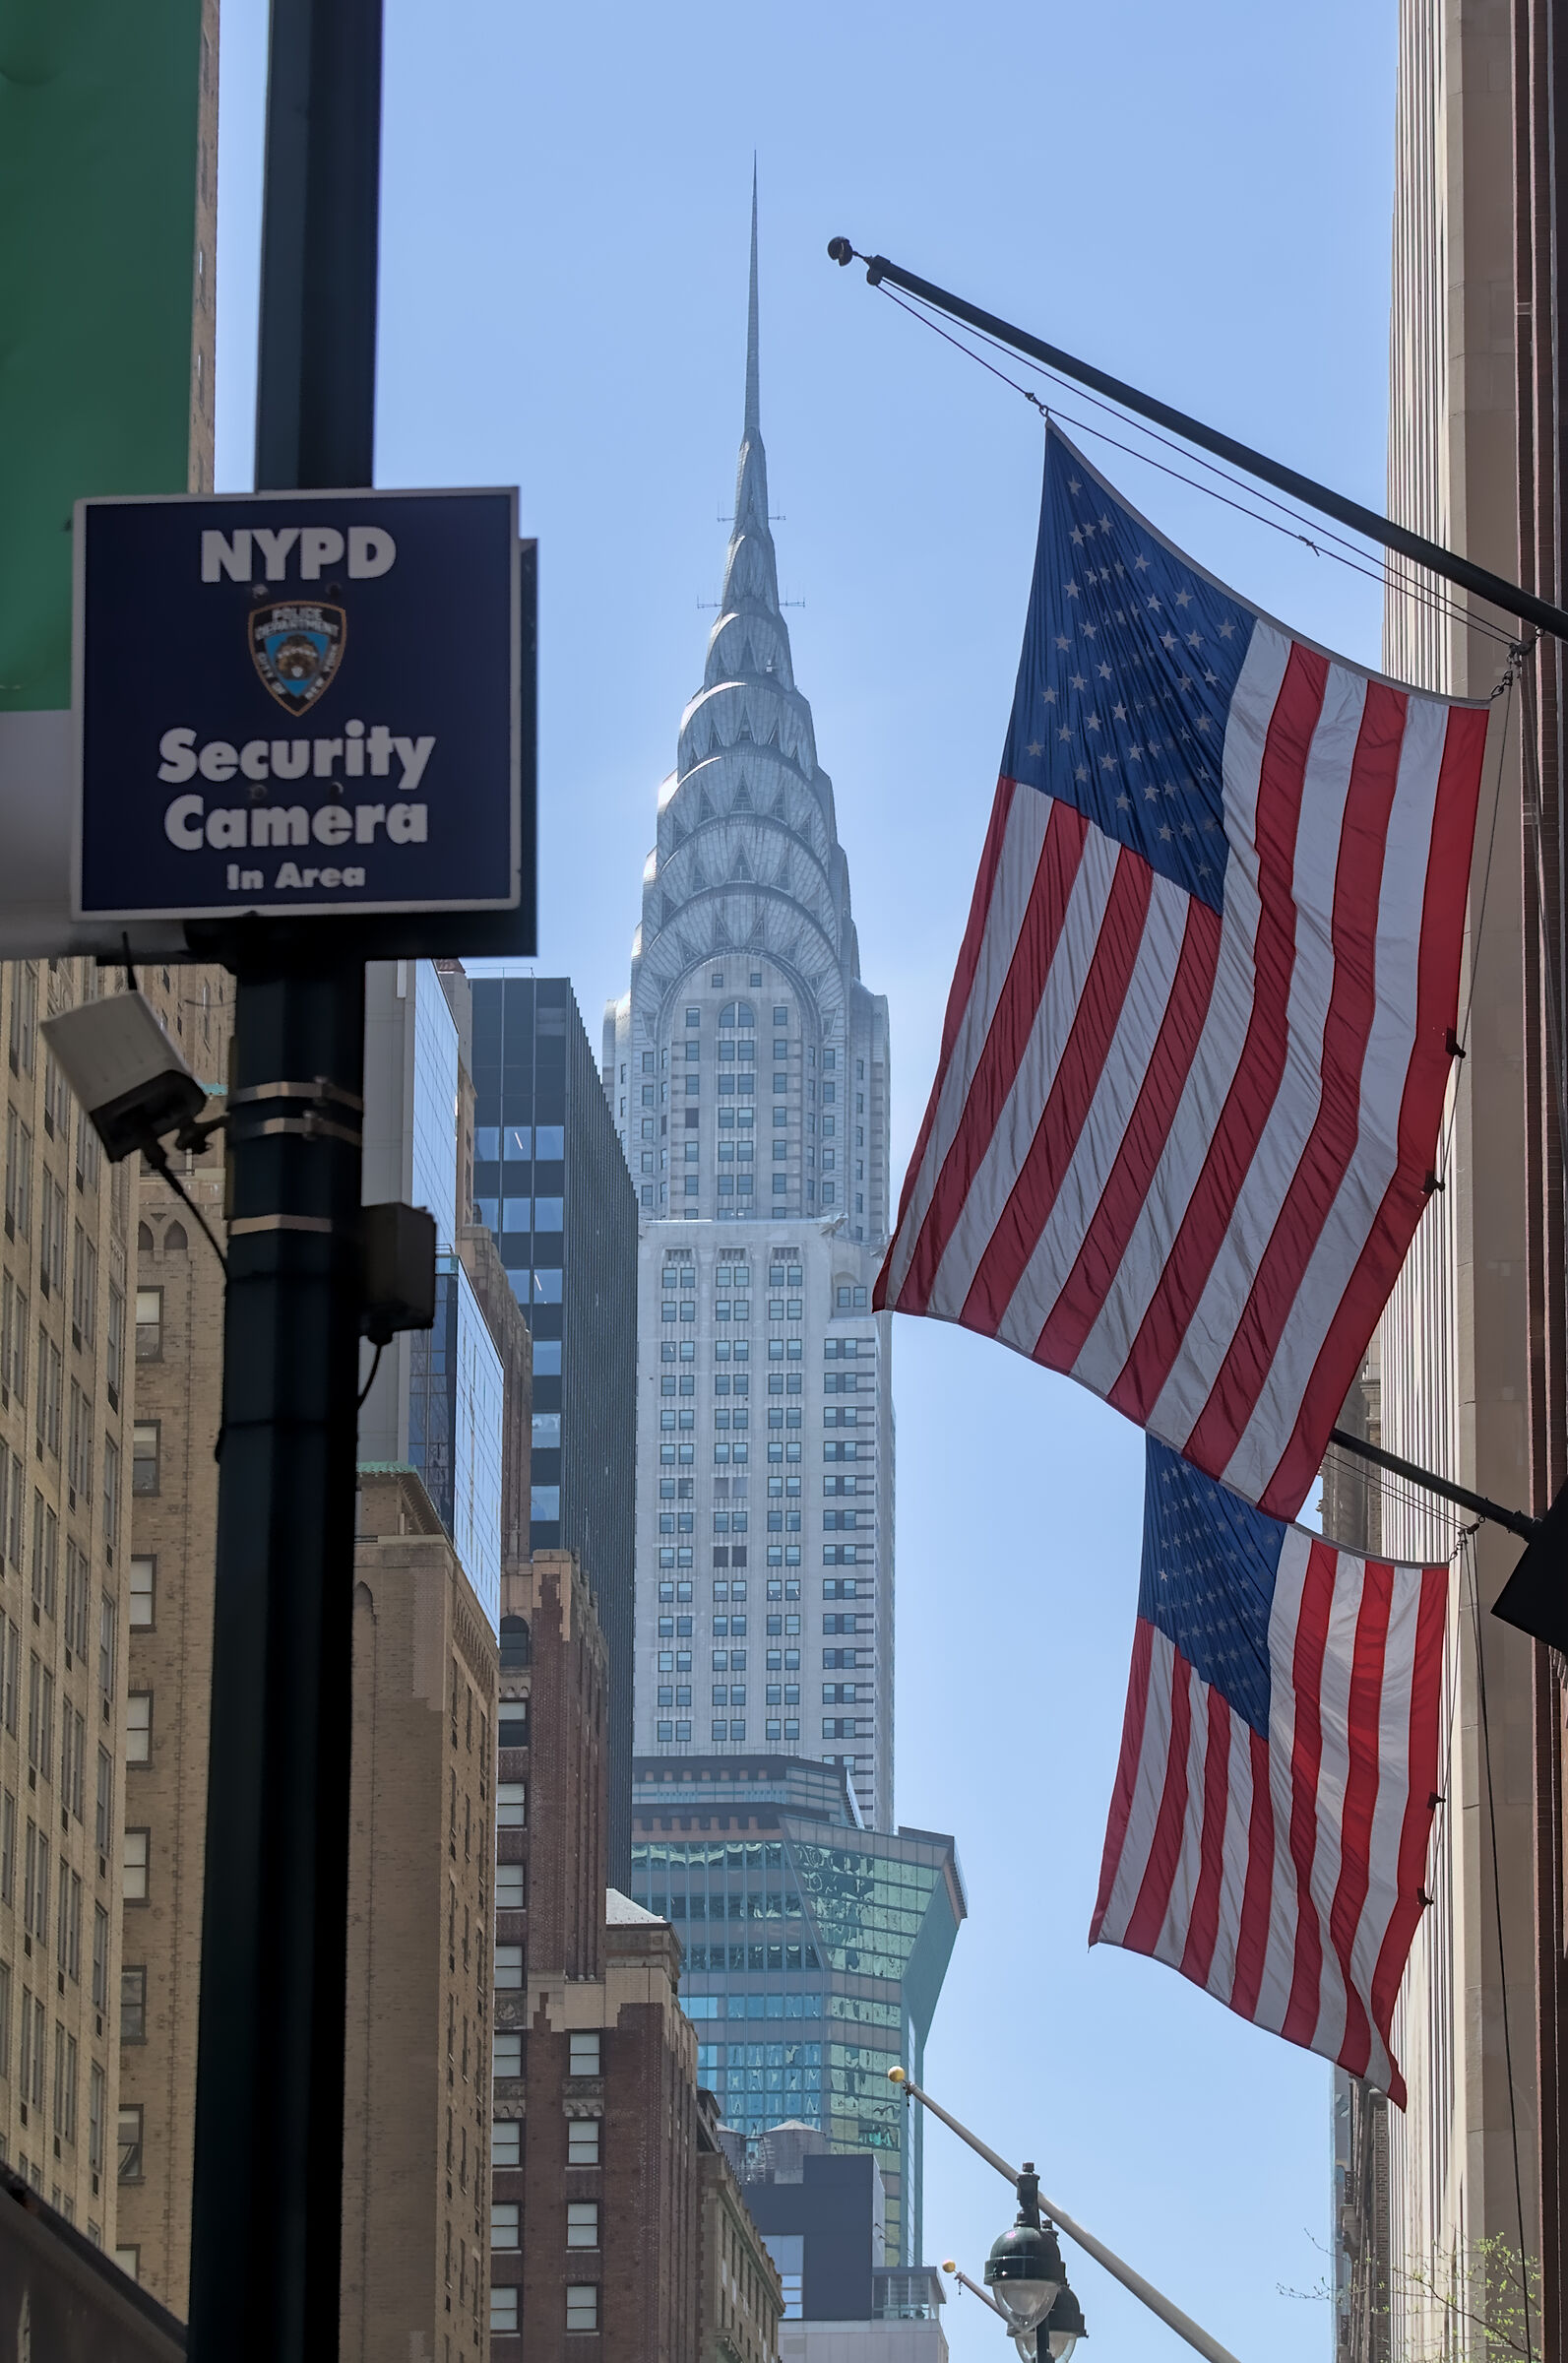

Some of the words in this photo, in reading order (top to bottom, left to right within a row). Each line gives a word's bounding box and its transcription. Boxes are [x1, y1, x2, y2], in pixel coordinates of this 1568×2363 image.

[201, 526, 397, 583] NYPD
[255, 618, 339, 641] DEPARTMENT
[272, 607, 323, 622] POLICE
[157, 719, 436, 790] Security
[164, 794, 428, 851] Camera
[226, 863, 264, 891] In
[275, 862, 365, 889] Area
